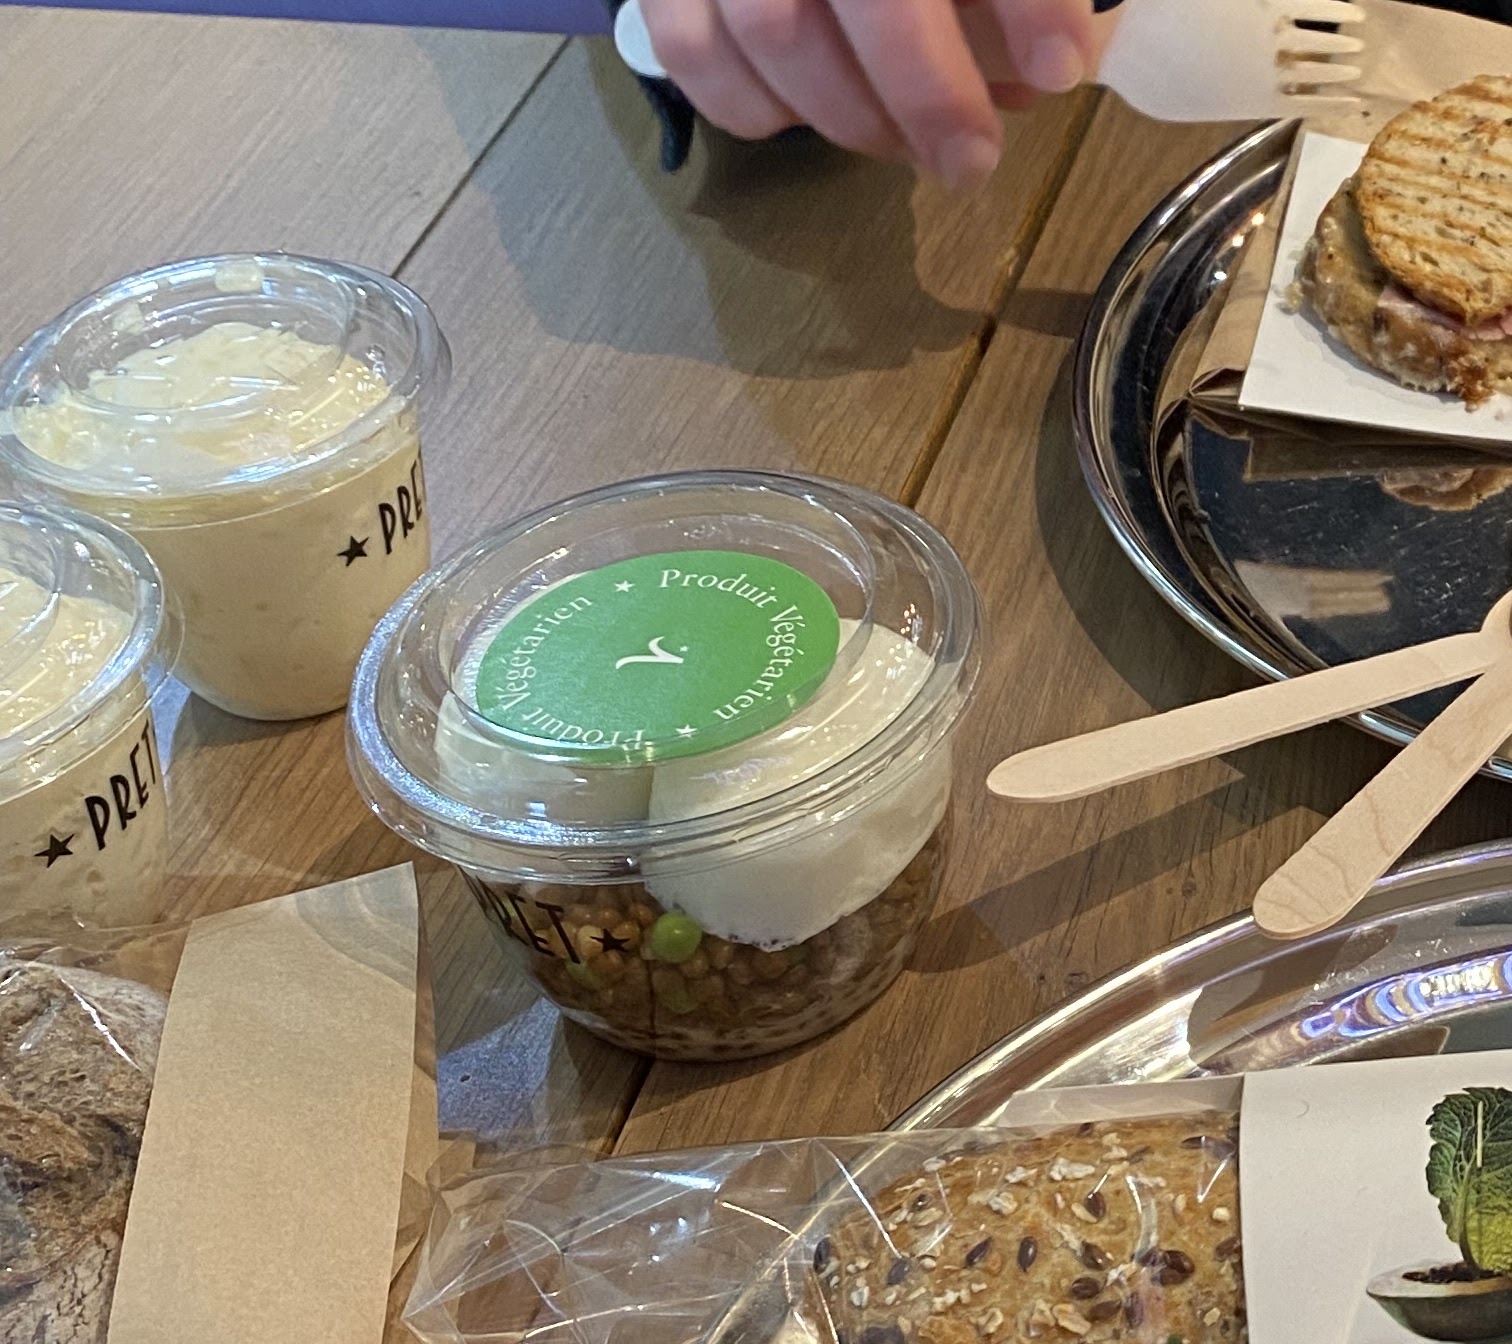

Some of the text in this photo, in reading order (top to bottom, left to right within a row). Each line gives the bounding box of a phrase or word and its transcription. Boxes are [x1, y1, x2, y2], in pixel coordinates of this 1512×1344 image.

[378, 444, 426, 555] PRE
[495, 596, 593, 712] Végétarien
[659, 568, 806, 721] Produit Végétarien
[84, 719, 156, 851] PRET
